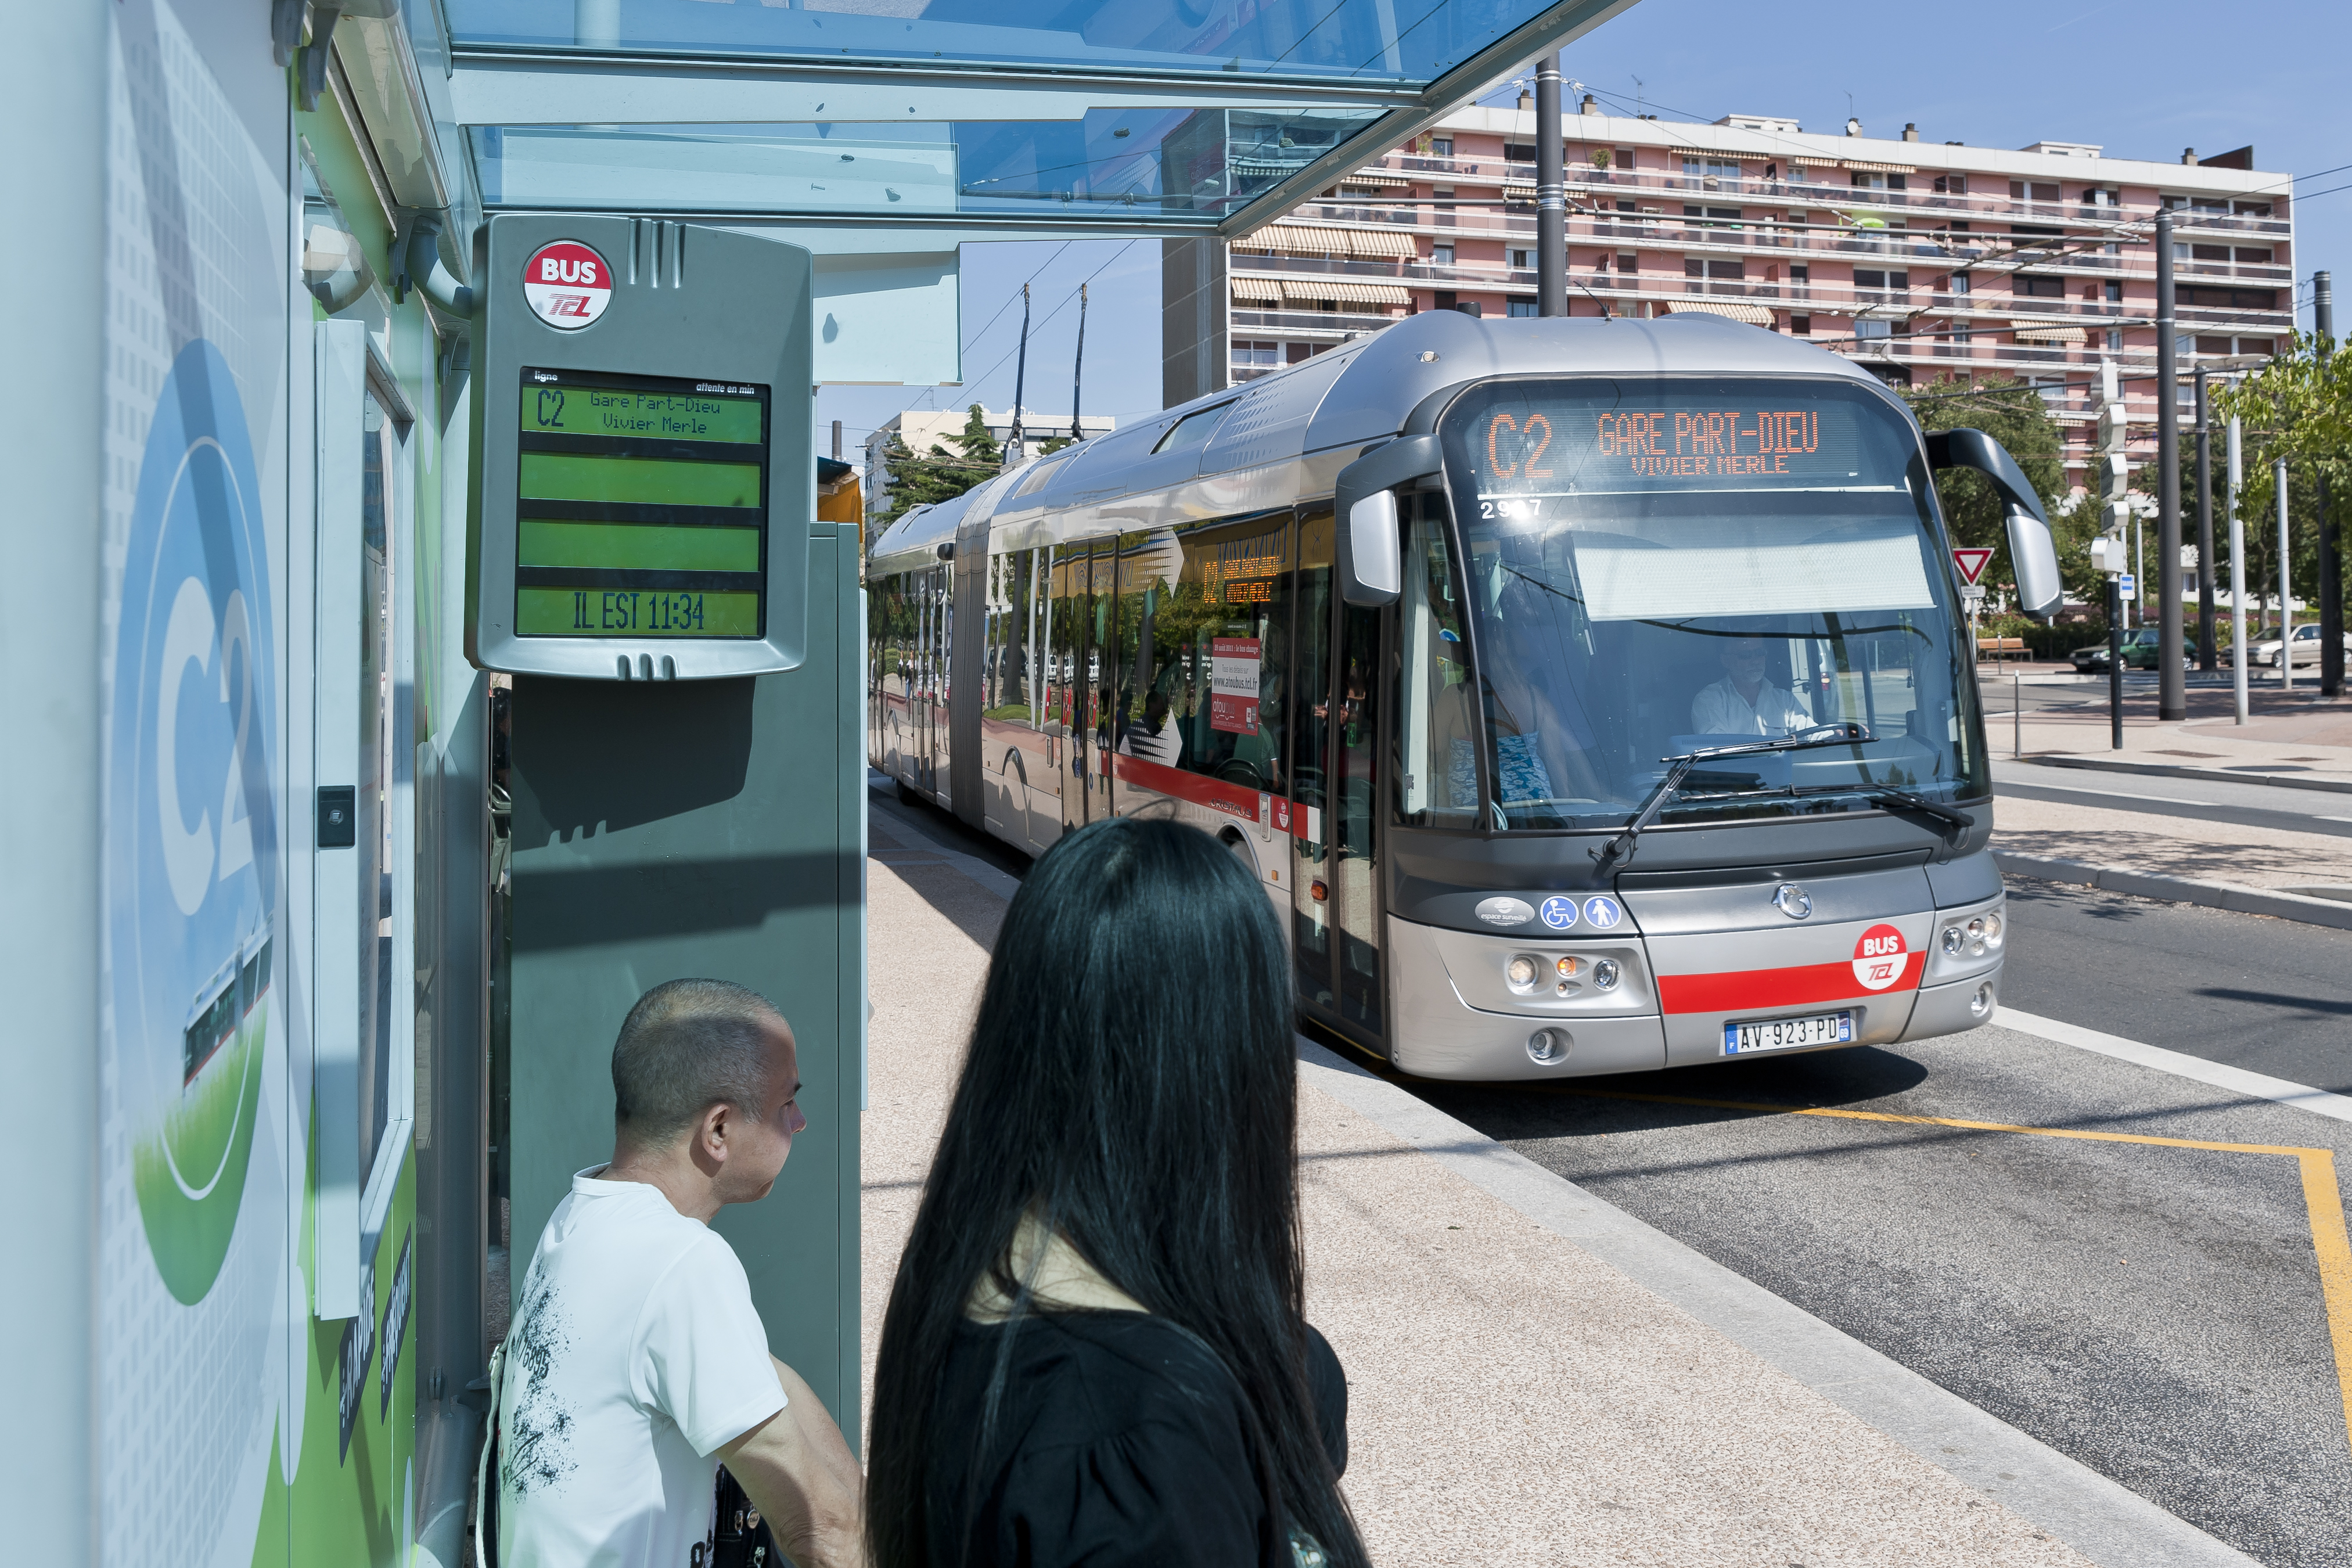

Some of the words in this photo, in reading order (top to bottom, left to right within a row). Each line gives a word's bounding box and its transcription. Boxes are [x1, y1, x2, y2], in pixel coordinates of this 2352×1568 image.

[541, 258, 596, 284] BUS
[548, 293, 591, 318] TCL
[534, 371, 558, 382] ligne
[696, 383, 724, 394] attente
[739, 385, 754, 395] min
[537, 390, 565, 427] C2
[590, 392, 630, 408] Gare
[636, 394, 720, 414] Part-Dieu
[603, 413, 655, 430] Vivier
[663, 418, 707, 434] Merle
[1598, 412, 1666, 456] GARE
[1675, 411, 1819, 455] PART-DIEU
[1488, 413, 1553, 479] C2
[1631, 456, 1710, 476] VIVIER
[1717, 455, 1790, 474] MERLE
[1480, 499, 1541, 519] 297
[574, 592, 594, 629] IL
[602, 592, 640, 630] EST
[649, 594, 704, 630] 11:34
[1213, 676, 1257, 691] www.atoubus.tcl.fr
[156, 576, 253, 916] C2
[1863, 935, 1898, 956] BUS
[1866, 963, 1894, 983] TCL
[1741, 1017, 1837, 1049] AV-923-PD
[1840, 1028, 1848, 1038] 69
